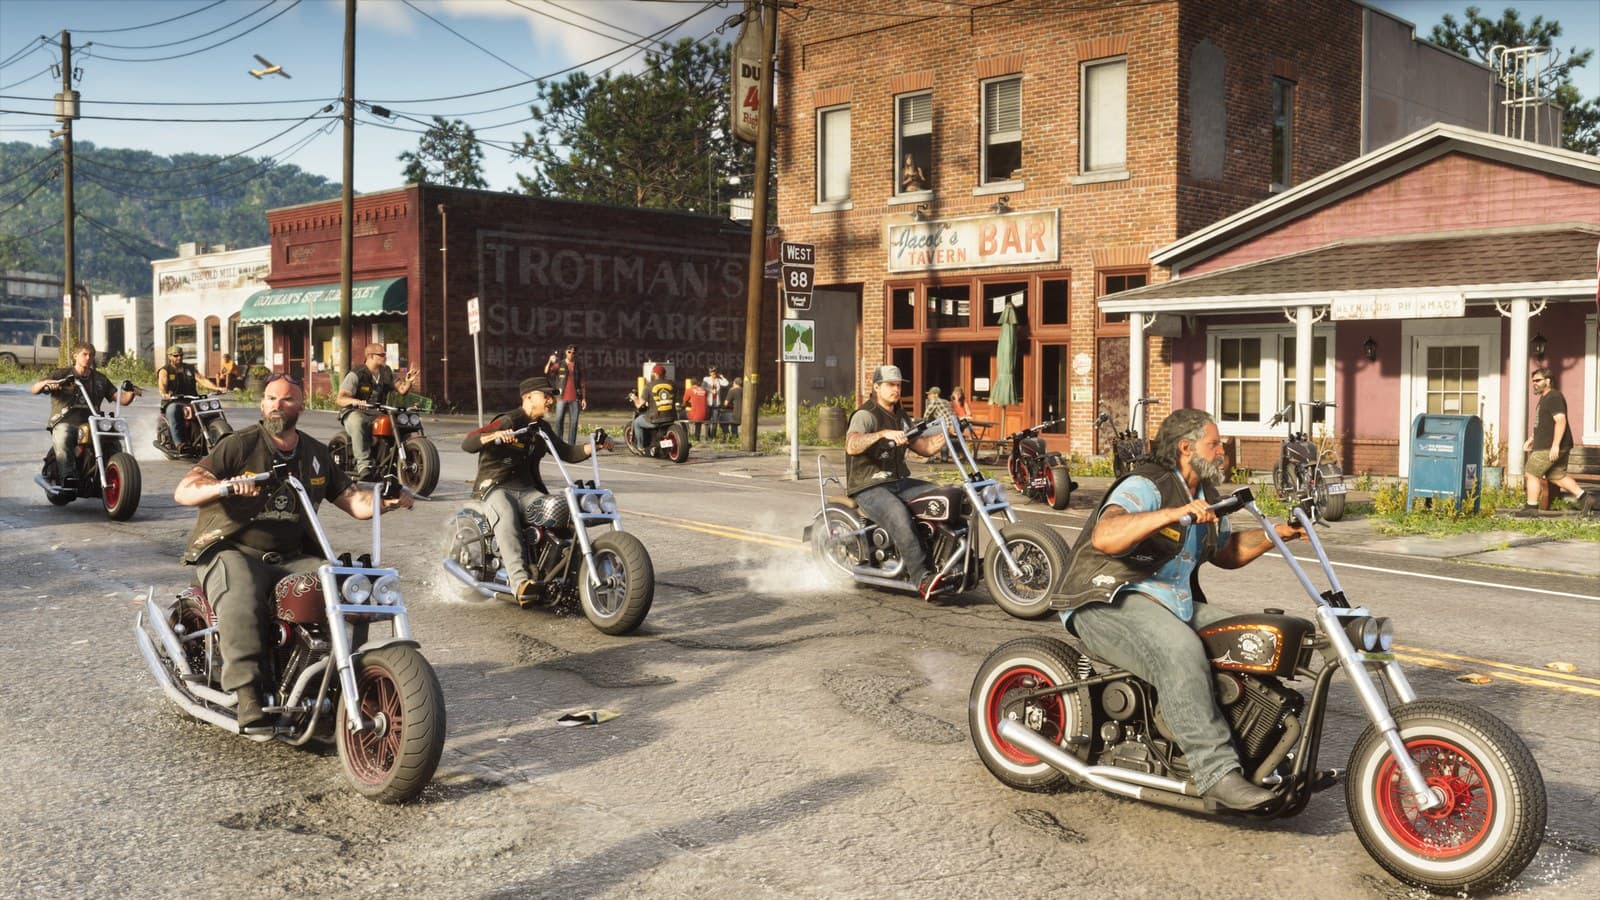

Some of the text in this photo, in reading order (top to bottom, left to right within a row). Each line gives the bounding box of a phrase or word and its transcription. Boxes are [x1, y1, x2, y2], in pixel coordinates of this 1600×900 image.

[743, 85, 760, 111] 4
[893, 218, 1046, 258] Jacob's BAR
[786, 245, 812, 260] WEST
[908, 247, 967, 265] TAVERN
[486, 242, 744, 298] TROTMAN'S
[790, 271, 808, 288] 88
[487, 303, 607, 340] SUPER
[617, 309, 745, 341] MARKET
[487, 346, 537, 368] MEAT
[575, 347, 655, 368] GETABLES
